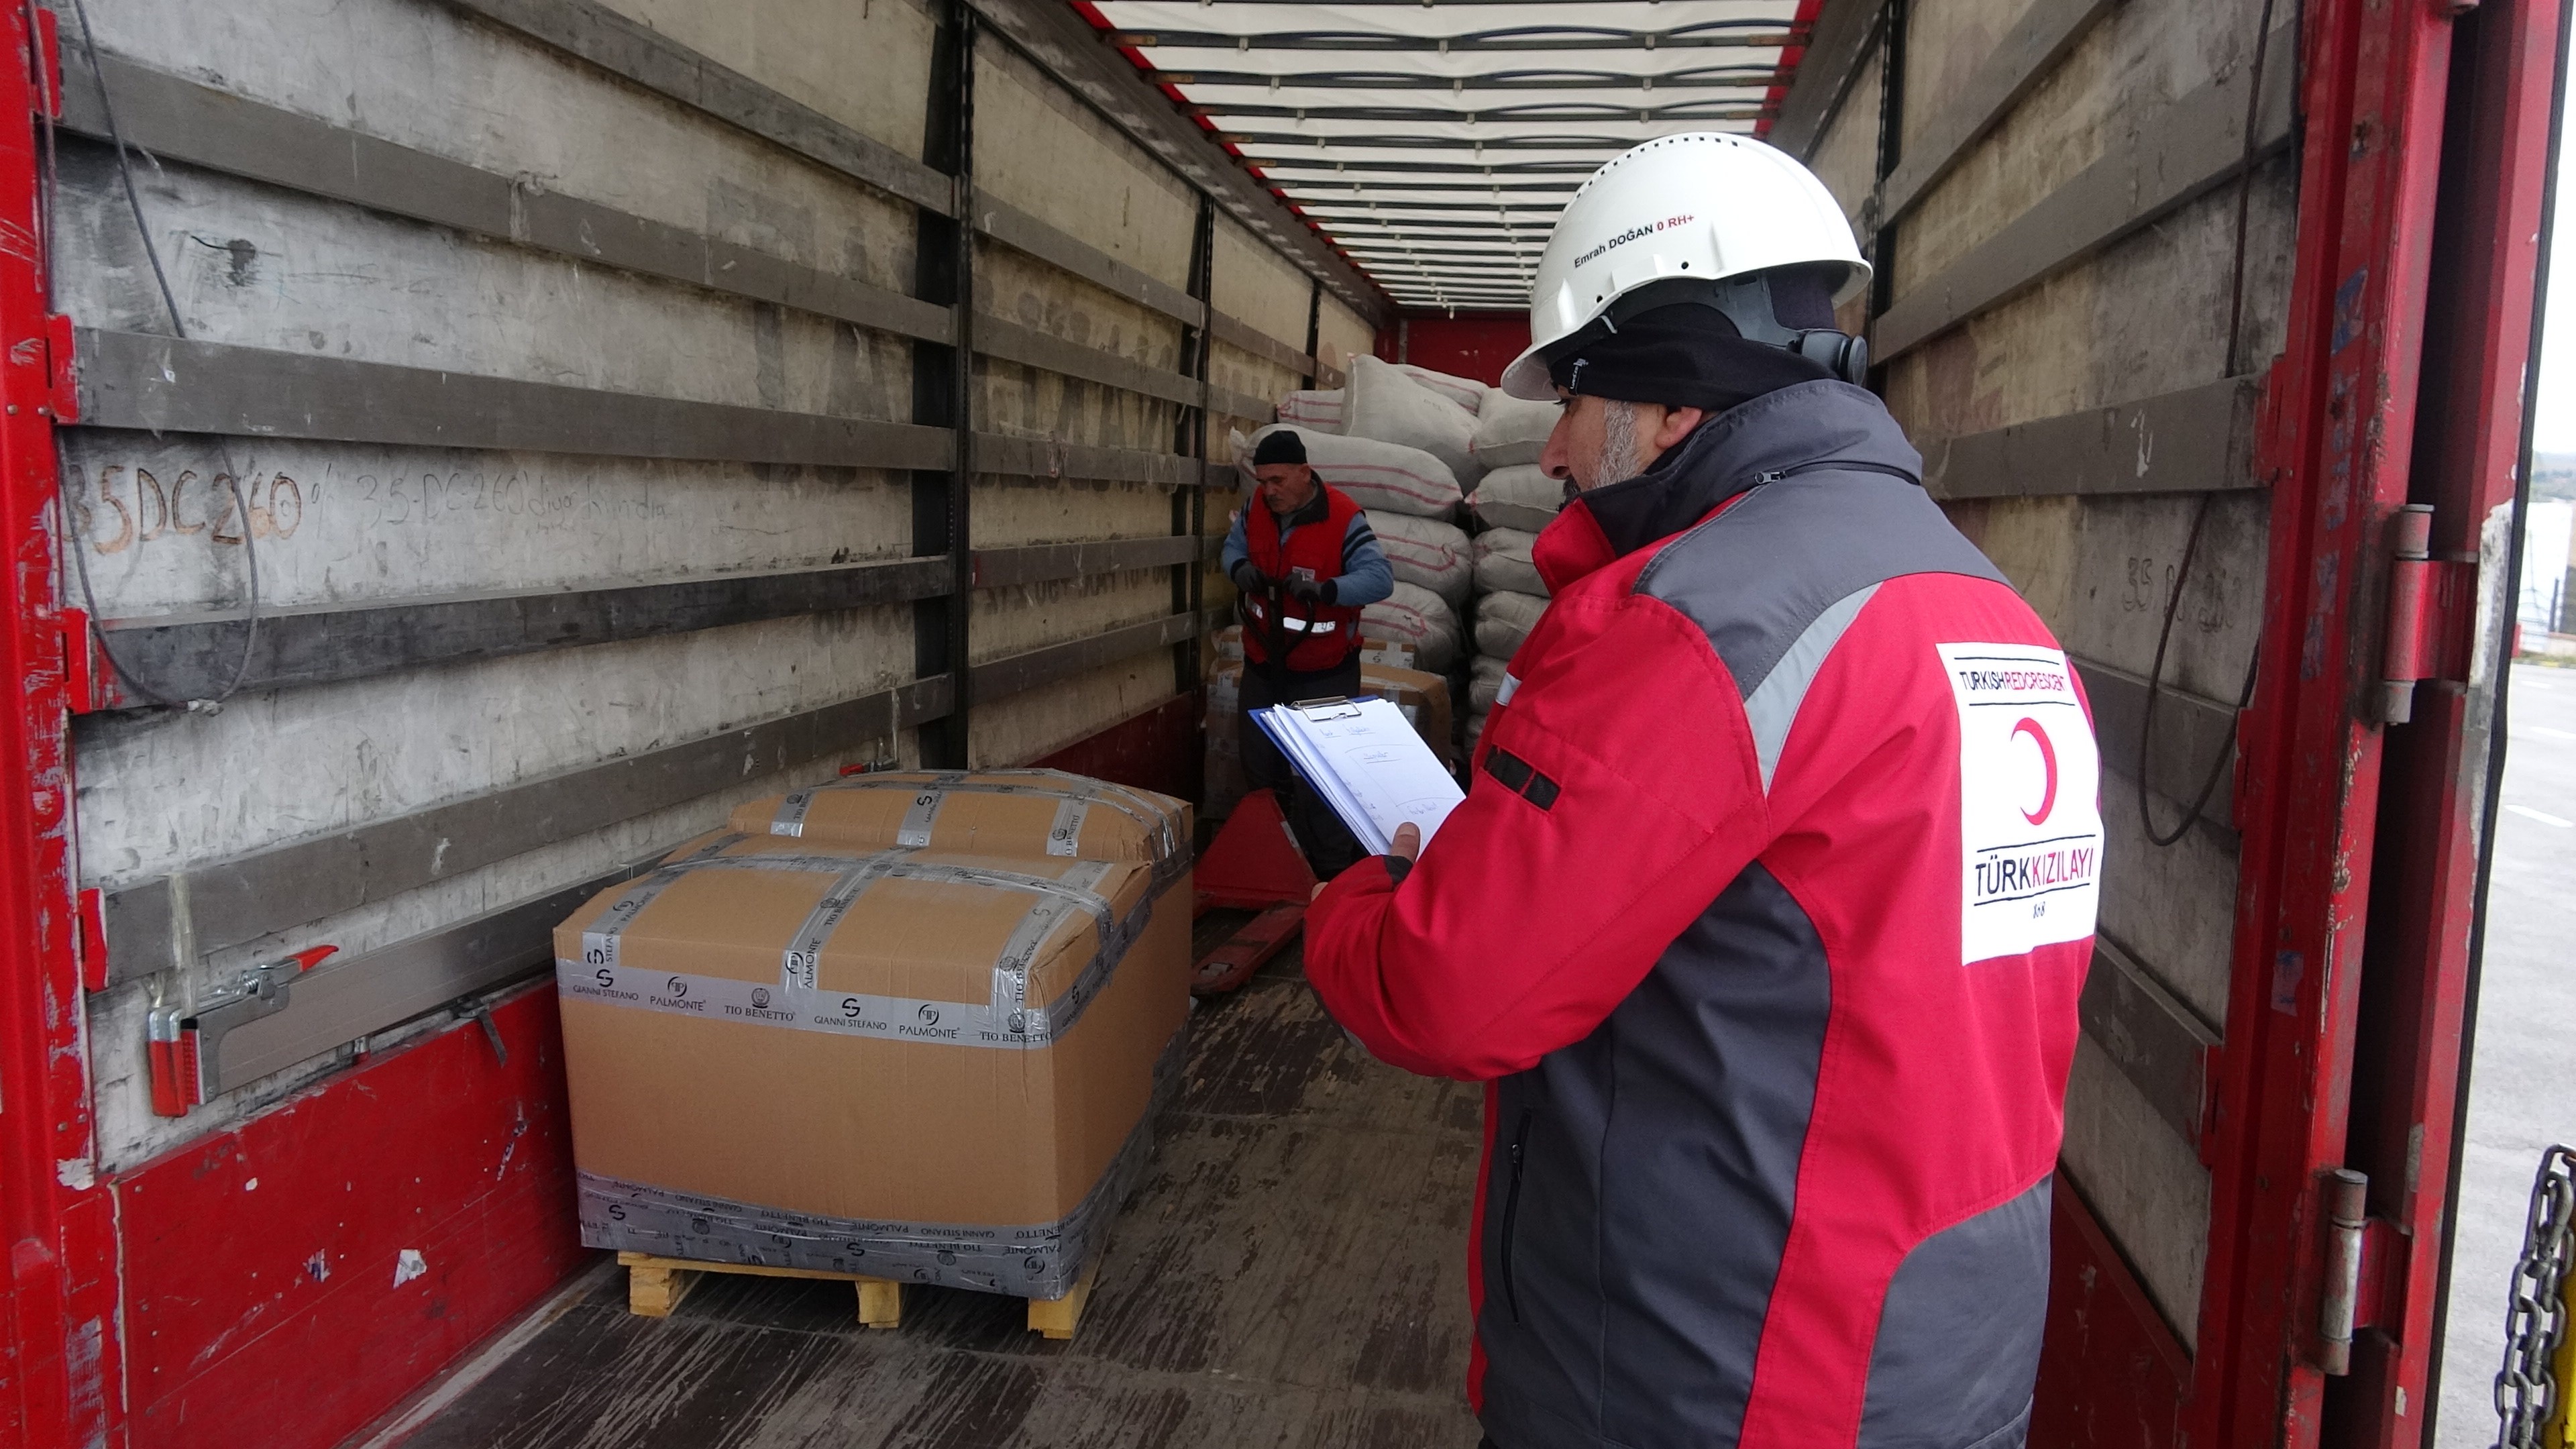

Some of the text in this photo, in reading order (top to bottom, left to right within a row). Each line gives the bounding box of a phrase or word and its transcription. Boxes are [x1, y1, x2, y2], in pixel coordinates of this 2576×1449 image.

[1574, 244, 1606, 268] Emrah
[1609, 225, 1653, 250] DOĞAN
[1668, 214, 1695, 227] RH+
[573, 985, 639, 1001] GIANNI STEFANO
[650, 996, 704, 1012] PALMONTE
[724, 1005, 794, 1022] TIO BENETTO
[814, 1016, 888, 1030] GIANNI STEFANO
[899, 1024, 958, 1039] PALMONTE
[979, 1030, 1053, 1044] TIO BENETTO
[852, 1221, 909, 1233] PALMONTE
[963, 1230, 996, 1238] GIANNI
[1005, 1244, 1062, 1255] PALMONTE
